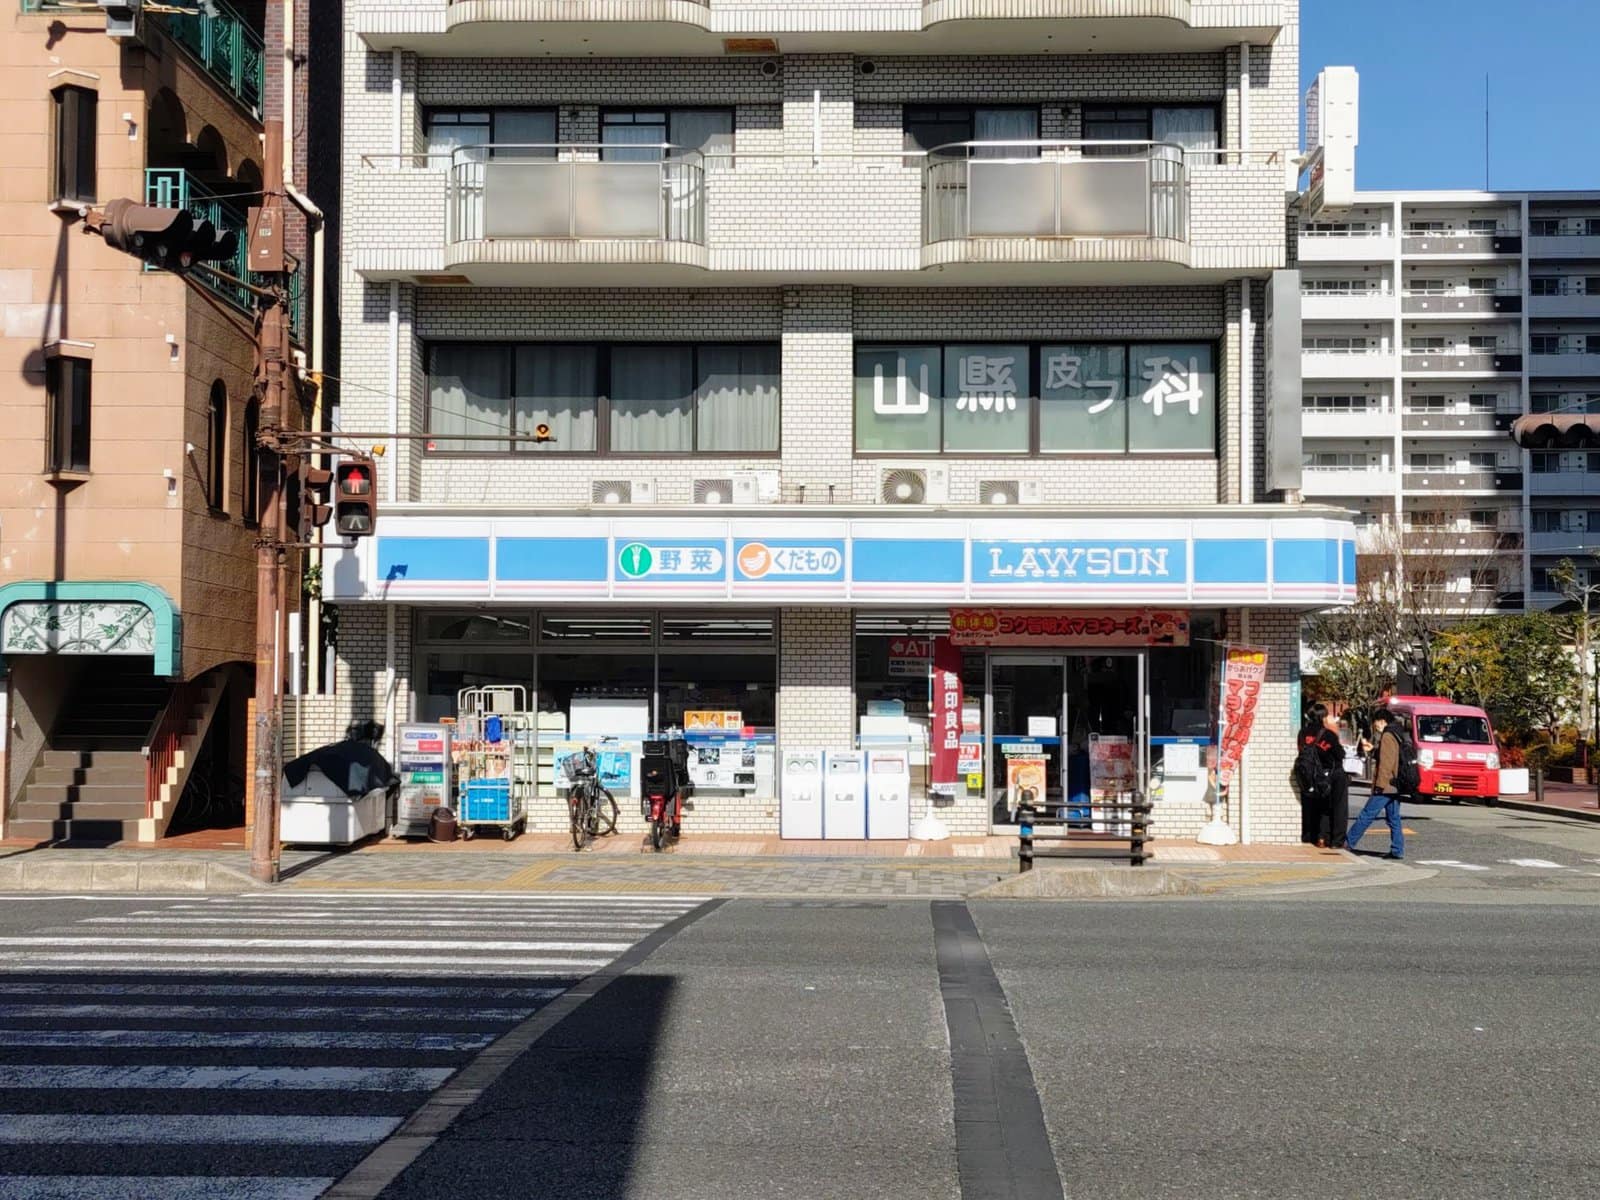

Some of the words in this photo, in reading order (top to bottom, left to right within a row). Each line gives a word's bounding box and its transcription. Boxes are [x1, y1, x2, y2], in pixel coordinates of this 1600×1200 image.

[659, 549, 713, 572] 野菜
[773, 550, 838, 572] くだもの
[989, 548, 1169, 577] LAWSON
[905, 641, 935, 656] AT
[943, 671, 959, 750] 無印良品
